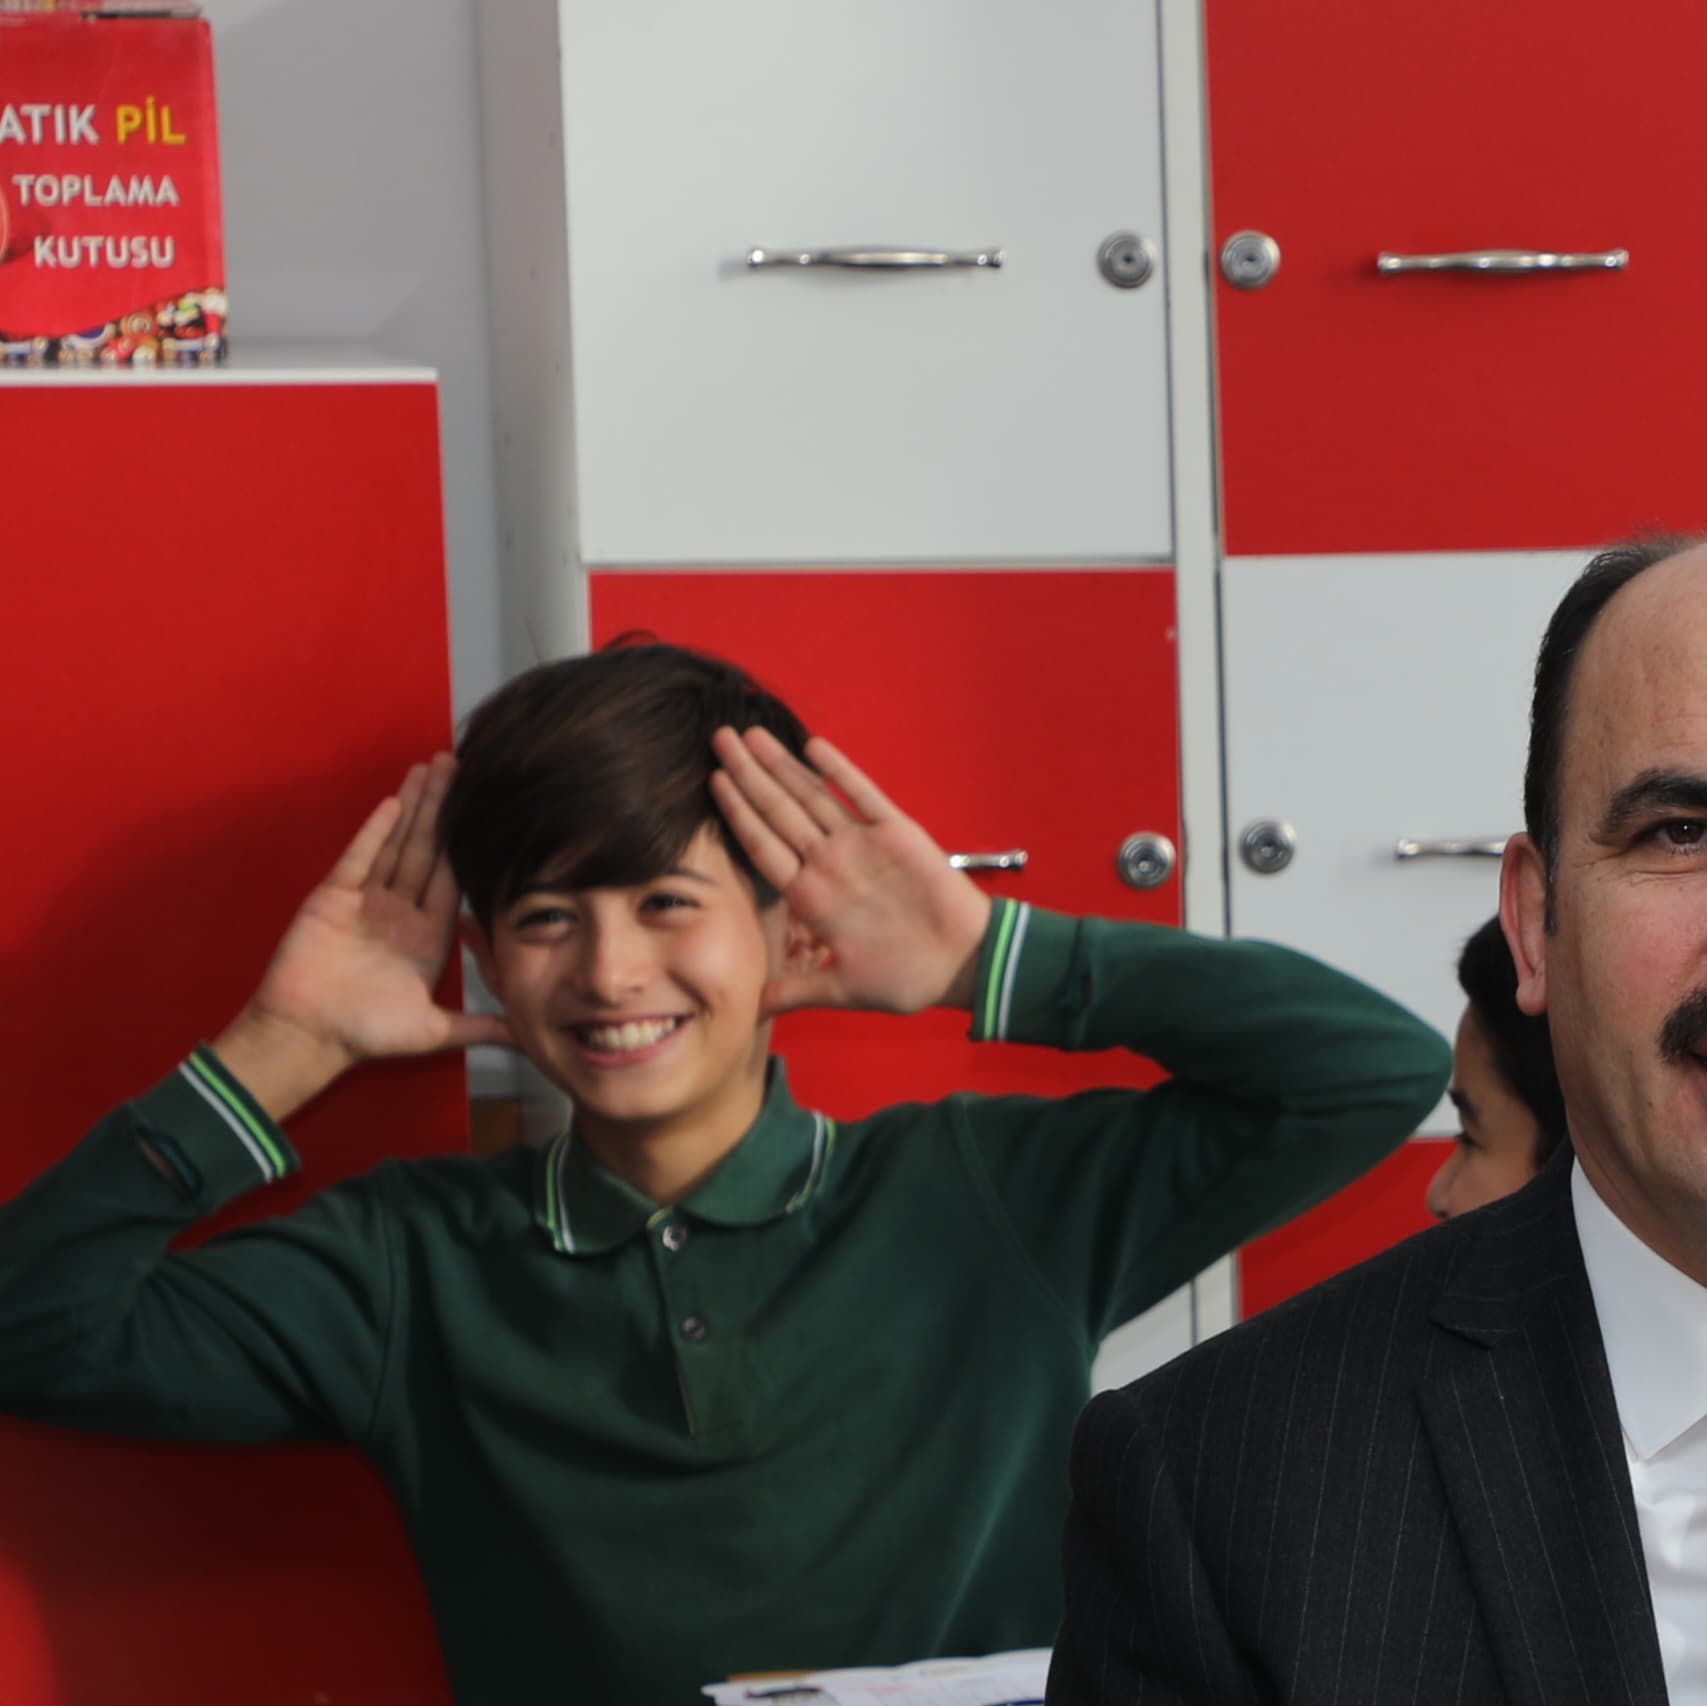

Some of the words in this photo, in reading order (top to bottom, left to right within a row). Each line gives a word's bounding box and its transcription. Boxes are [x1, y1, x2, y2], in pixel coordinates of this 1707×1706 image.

[0, 104, 98, 145] ATIK
[117, 97, 186, 145] PİL
[13, 175, 179, 207] TOPLAMA
[34, 237, 174, 268] KUTUSU
